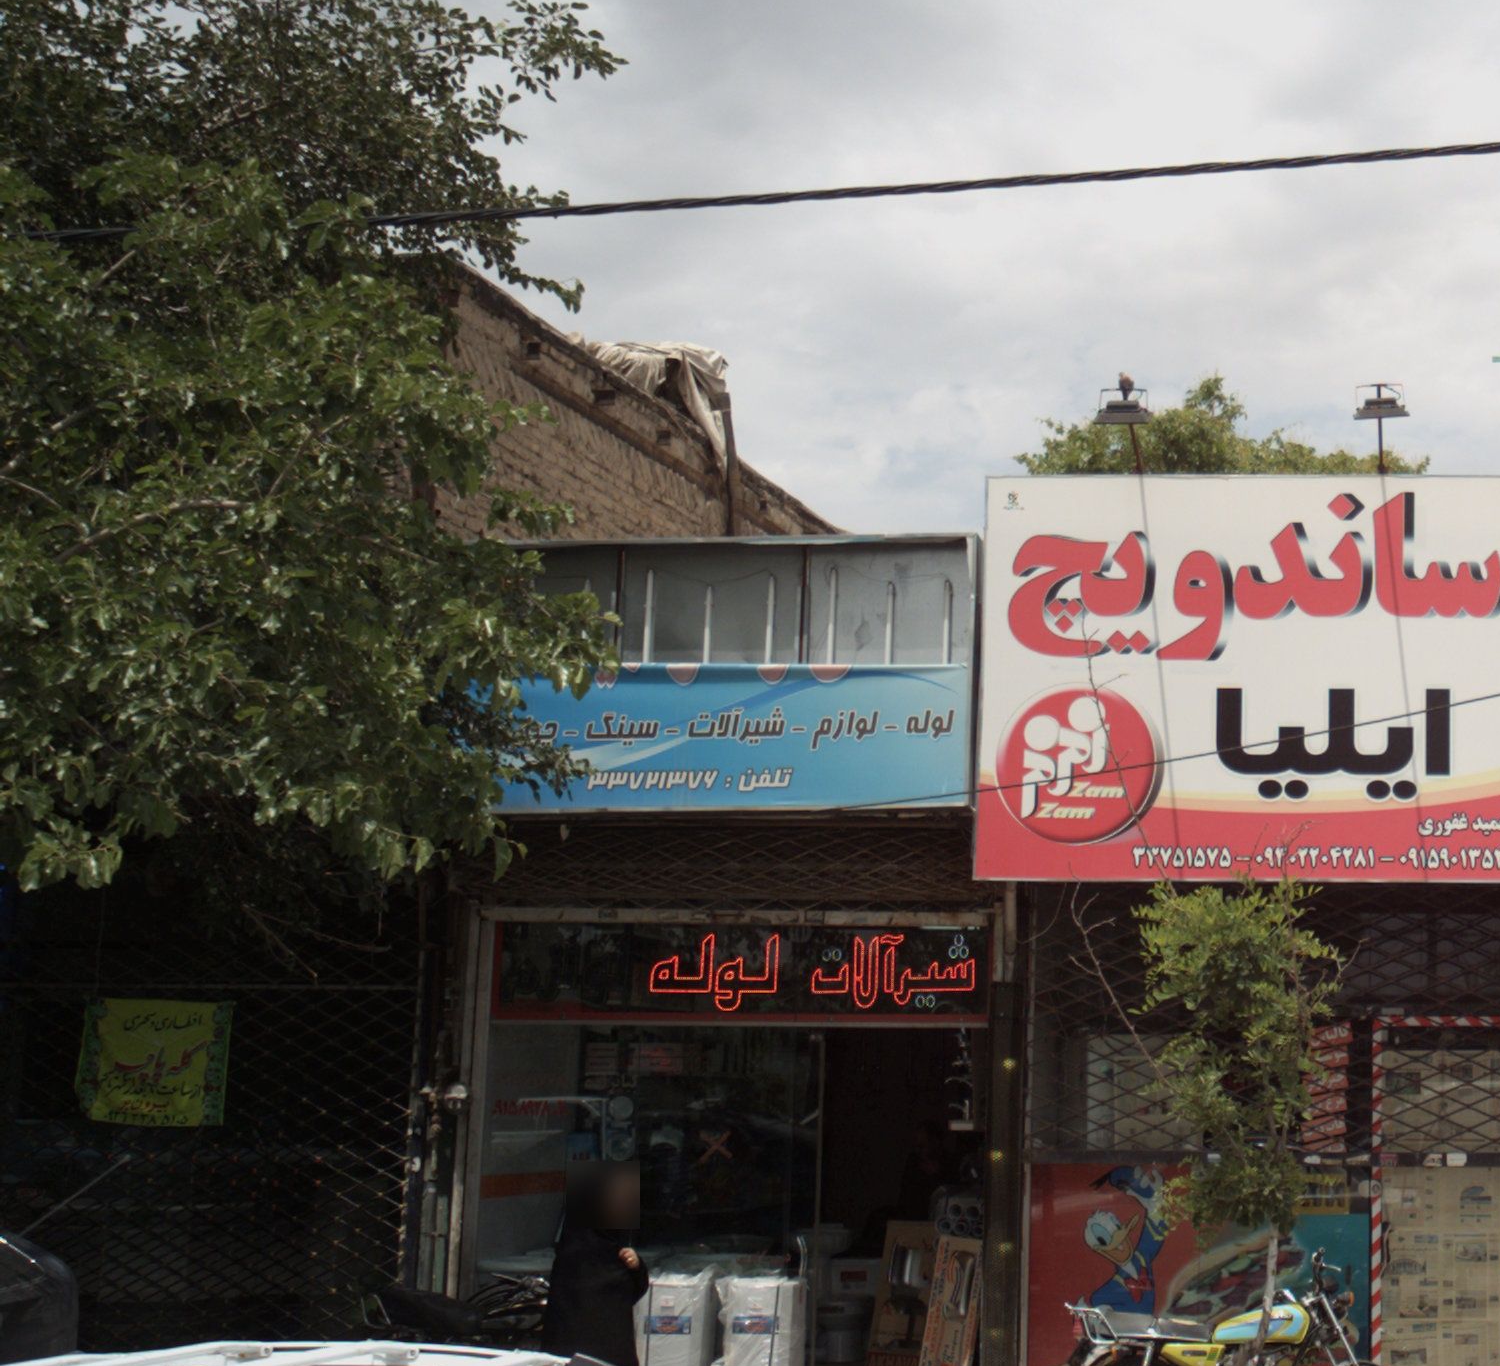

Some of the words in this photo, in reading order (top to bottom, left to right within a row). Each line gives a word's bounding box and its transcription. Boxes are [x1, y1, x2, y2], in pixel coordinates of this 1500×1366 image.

[687, 707, 786, 745] شیرآلات
[811, 710, 880, 751] لوازم
[905, 708, 955, 739] لوله
[1215, 687, 1452, 803] ایلیا
[737, 767, 793, 793] تلفن
[1067, 781, 1127, 799] Zam
[1035, 802, 1096, 819] Zam
[1416, 813, 1468, 837] غفوری
[649, 932, 780, 1012] لوله
[810, 932, 977, 1009] شیرآلات
